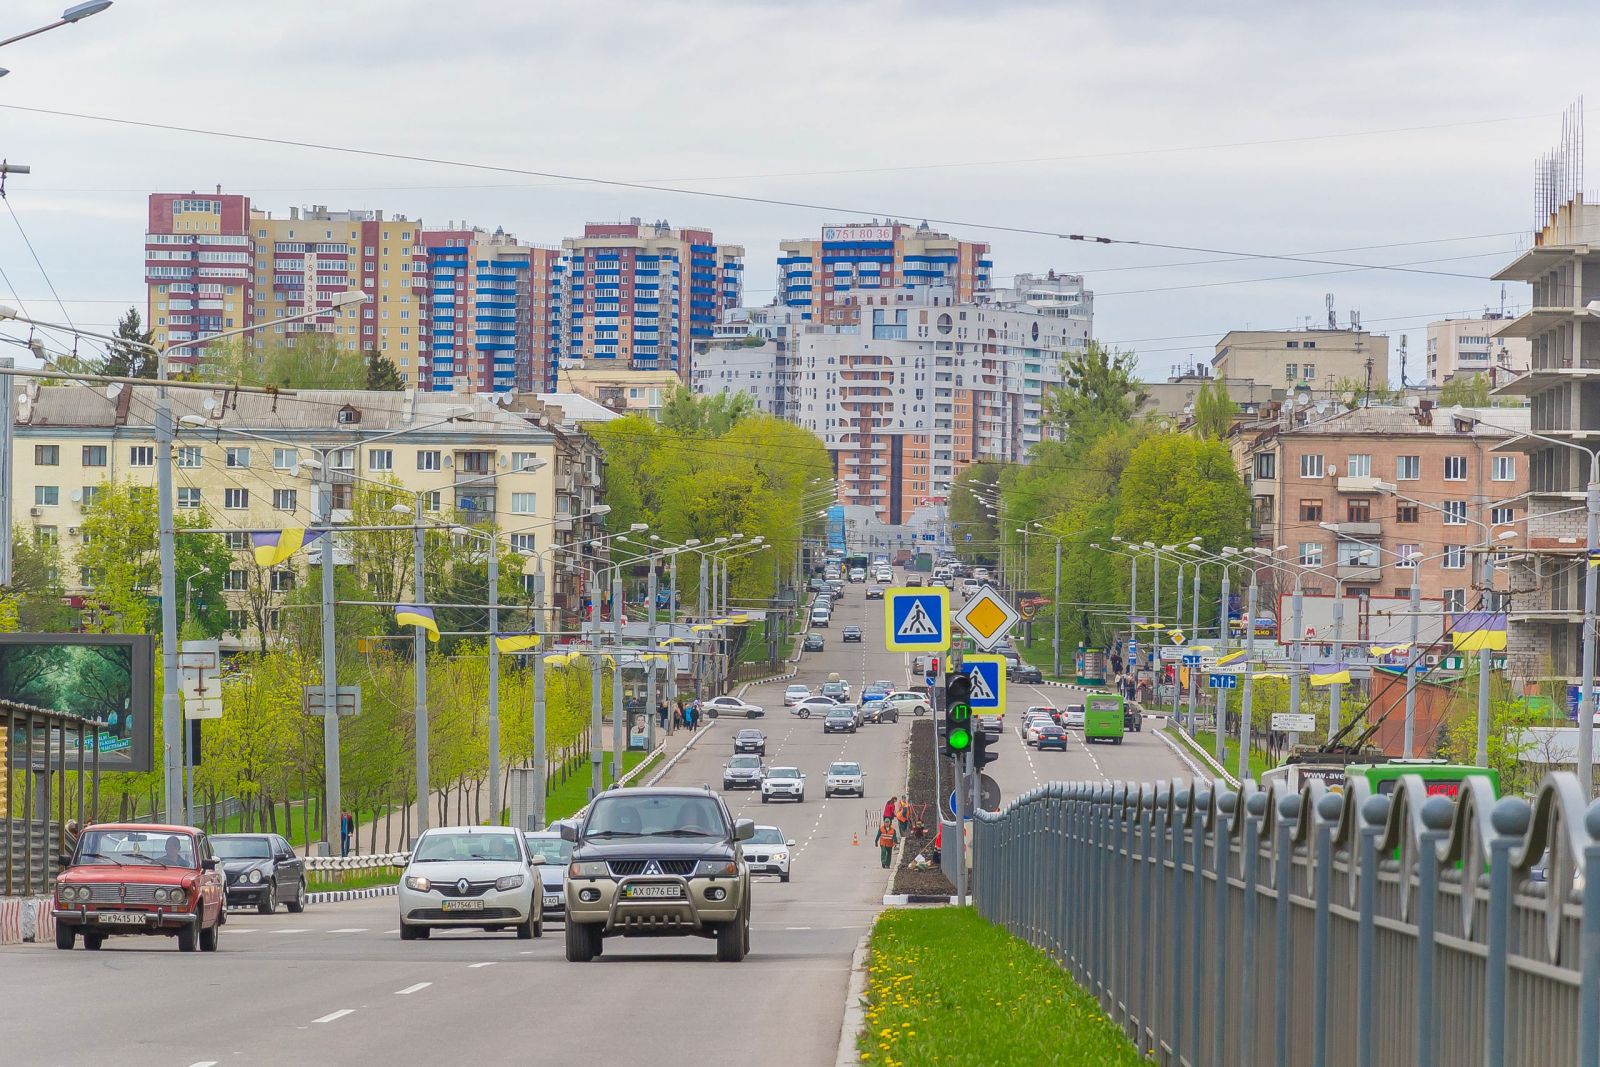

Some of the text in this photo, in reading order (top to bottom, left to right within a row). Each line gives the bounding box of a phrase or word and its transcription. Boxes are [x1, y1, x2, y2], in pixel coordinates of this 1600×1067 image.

[836, 229, 855, 239] 751
[859, 229, 873, 239] 80
[877, 228, 889, 239] 36
[955, 704, 967, 721] 17
[632, 887, 679, 896] AX 0776 EE
[112, 914, 131, 923] 9415
